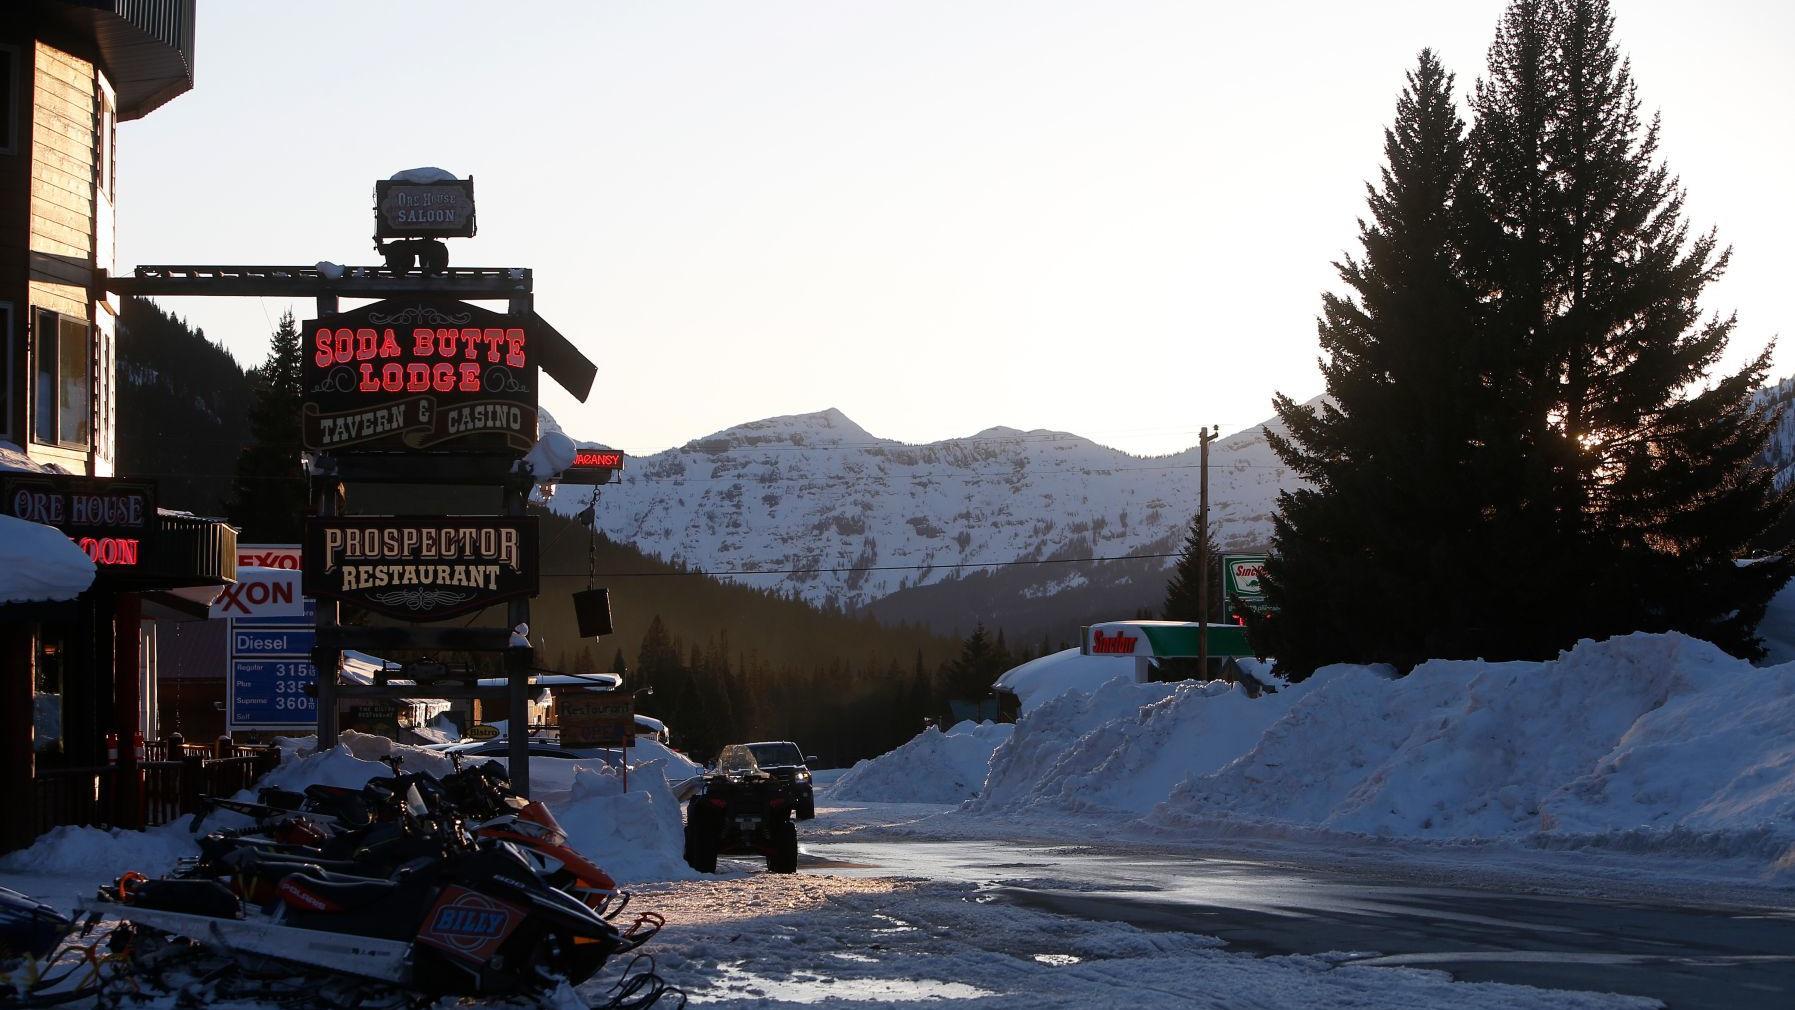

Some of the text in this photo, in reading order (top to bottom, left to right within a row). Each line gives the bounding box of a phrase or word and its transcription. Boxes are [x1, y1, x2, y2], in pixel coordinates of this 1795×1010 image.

[423, 192, 456, 207] HOUSE
[398, 209, 456, 222] SALOON
[315, 328, 526, 369] SODA BUTTE
[359, 362, 481, 392] LODGE
[320, 399, 521, 444] TAVERN & CASINO
[14, 489, 144, 528] ORE HOUSE
[323, 528, 522, 575] PROSPECTOR
[341, 565, 500, 592] RESTAURANT
[237, 635, 288, 650] Diesel
[1093, 629, 1138, 654] Sinclair
[237, 664, 264, 672] Regular
[276, 664, 307, 676] 315
[275, 697, 307, 710] 360
[561, 702, 629, 715] Restaurant
[471, 728, 497, 736] Bistro
[434, 908, 506, 934] BILLY
